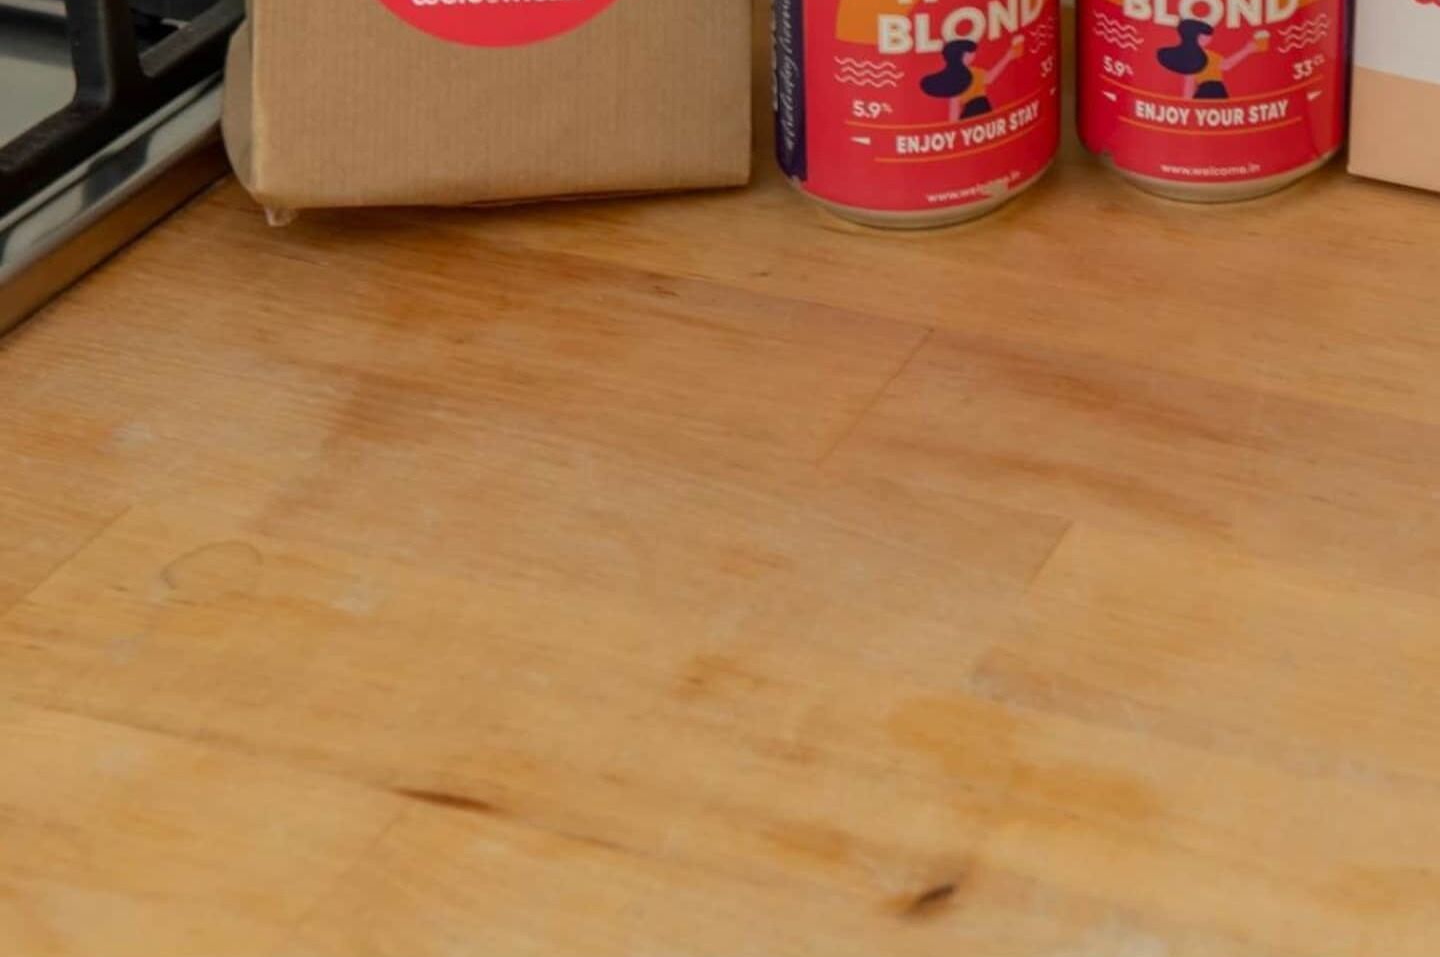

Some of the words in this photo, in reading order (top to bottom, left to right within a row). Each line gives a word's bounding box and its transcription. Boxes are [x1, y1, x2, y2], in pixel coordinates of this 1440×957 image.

[896, 131, 956, 154] ENJOY
[961, 118, 1006, 147] YOUR
[1009, 100, 1040, 131] STAY
[1135, 99, 1190, 125] ENJOY
[1195, 107, 1245, 127] YOUR
[1248, 99, 1289, 124] STAY
